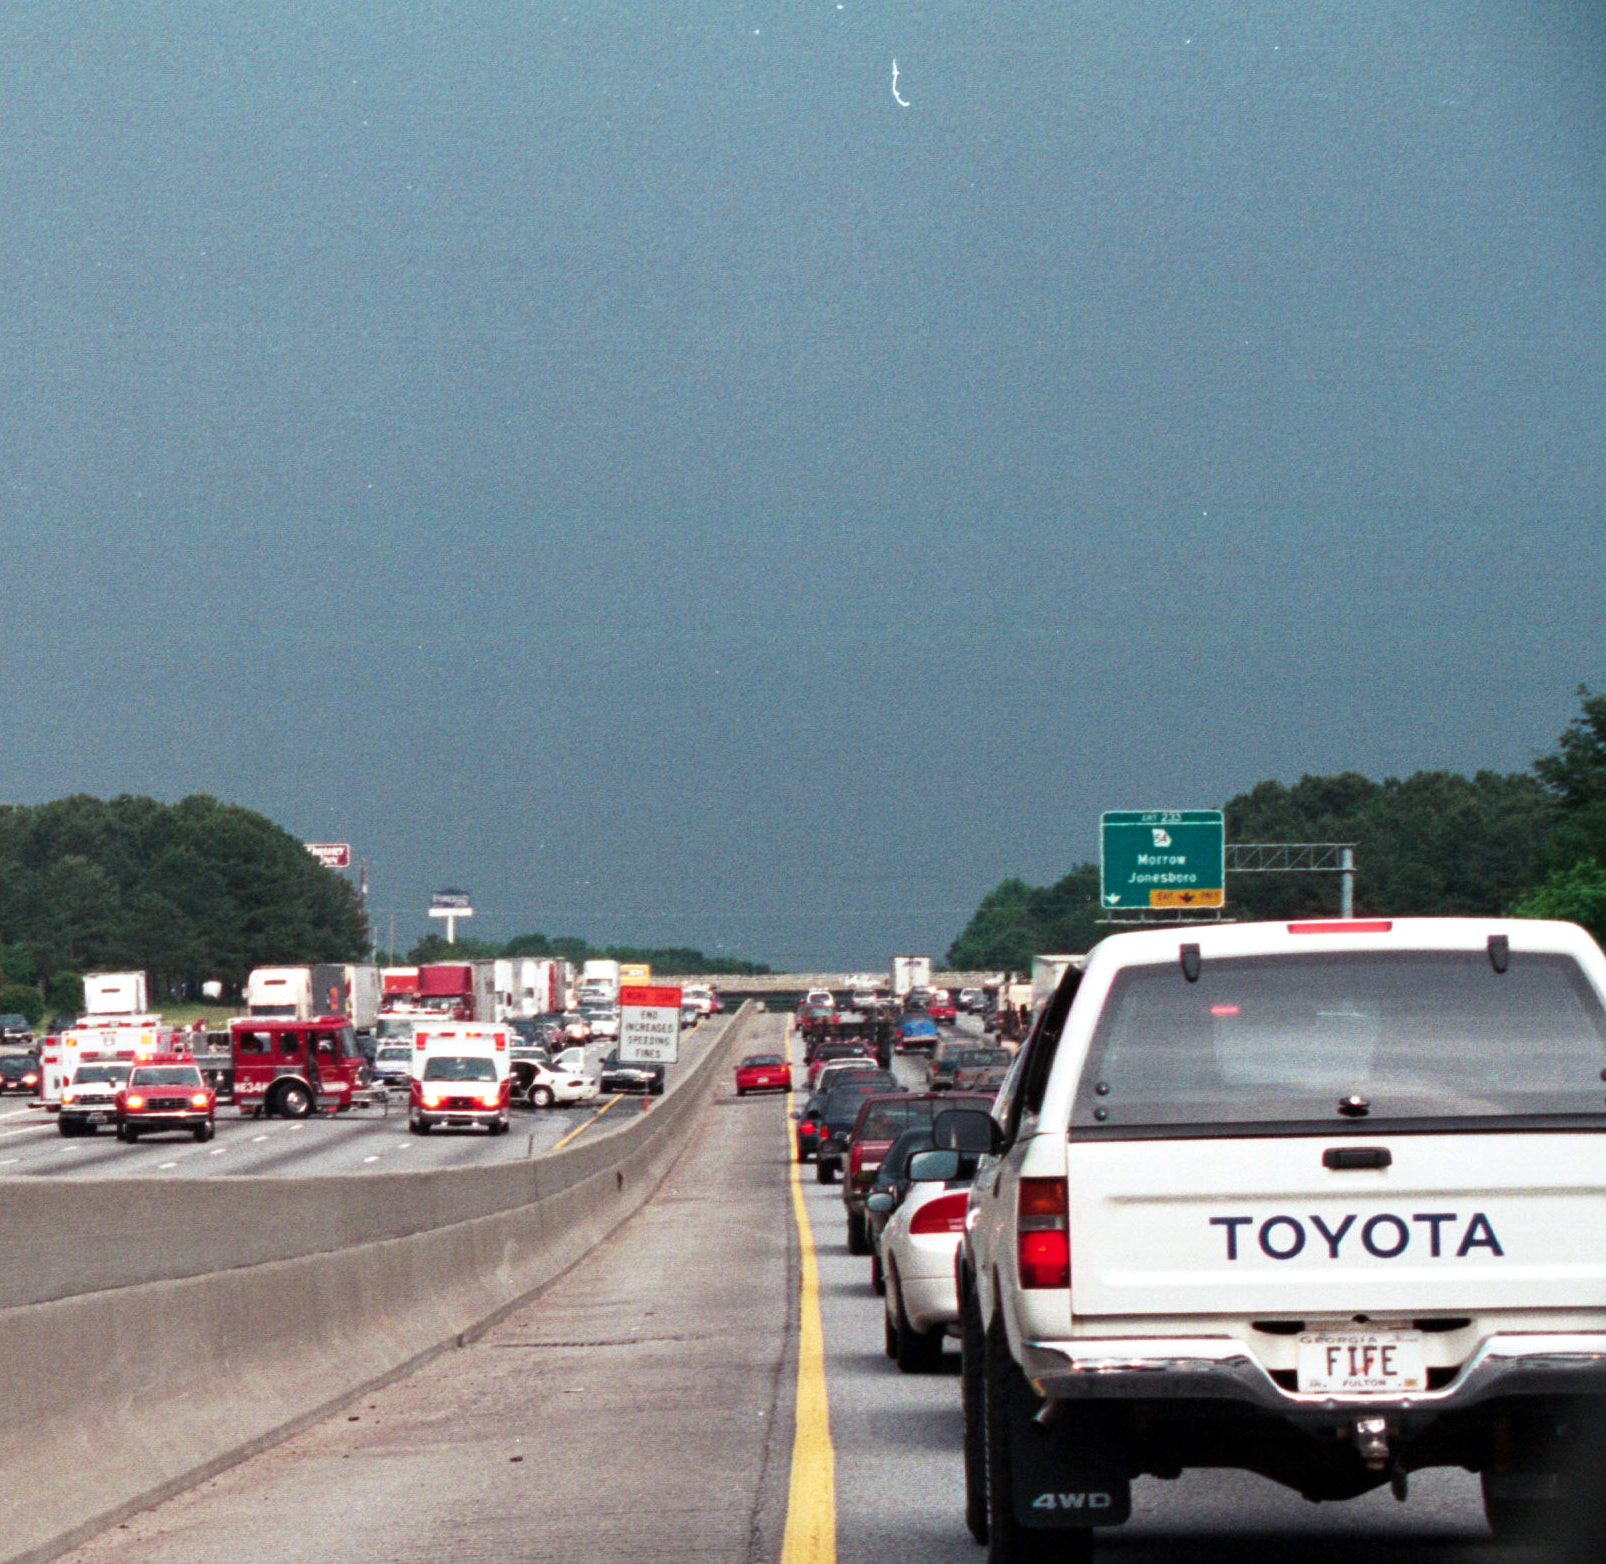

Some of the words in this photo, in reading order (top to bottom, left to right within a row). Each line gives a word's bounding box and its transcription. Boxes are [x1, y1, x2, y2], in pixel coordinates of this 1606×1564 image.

[1137, 854, 1186, 865] Morrow
[1127, 872, 1197, 884] Jonesboro
[641, 1010, 658, 1019] END
[626, 1023, 674, 1033] INCREASED
[628, 1035, 671, 1046] SPEEDING
[635, 1048, 661, 1058] FINES
[1208, 1212, 1505, 1260] TOYOTA
[1299, 1336, 1378, 1344] GEORGIA
[1326, 1345, 1397, 1376] FIFE
[1342, 1379, 1387, 1387] FULTON
[1032, 1493, 1112, 1509] 4WD
